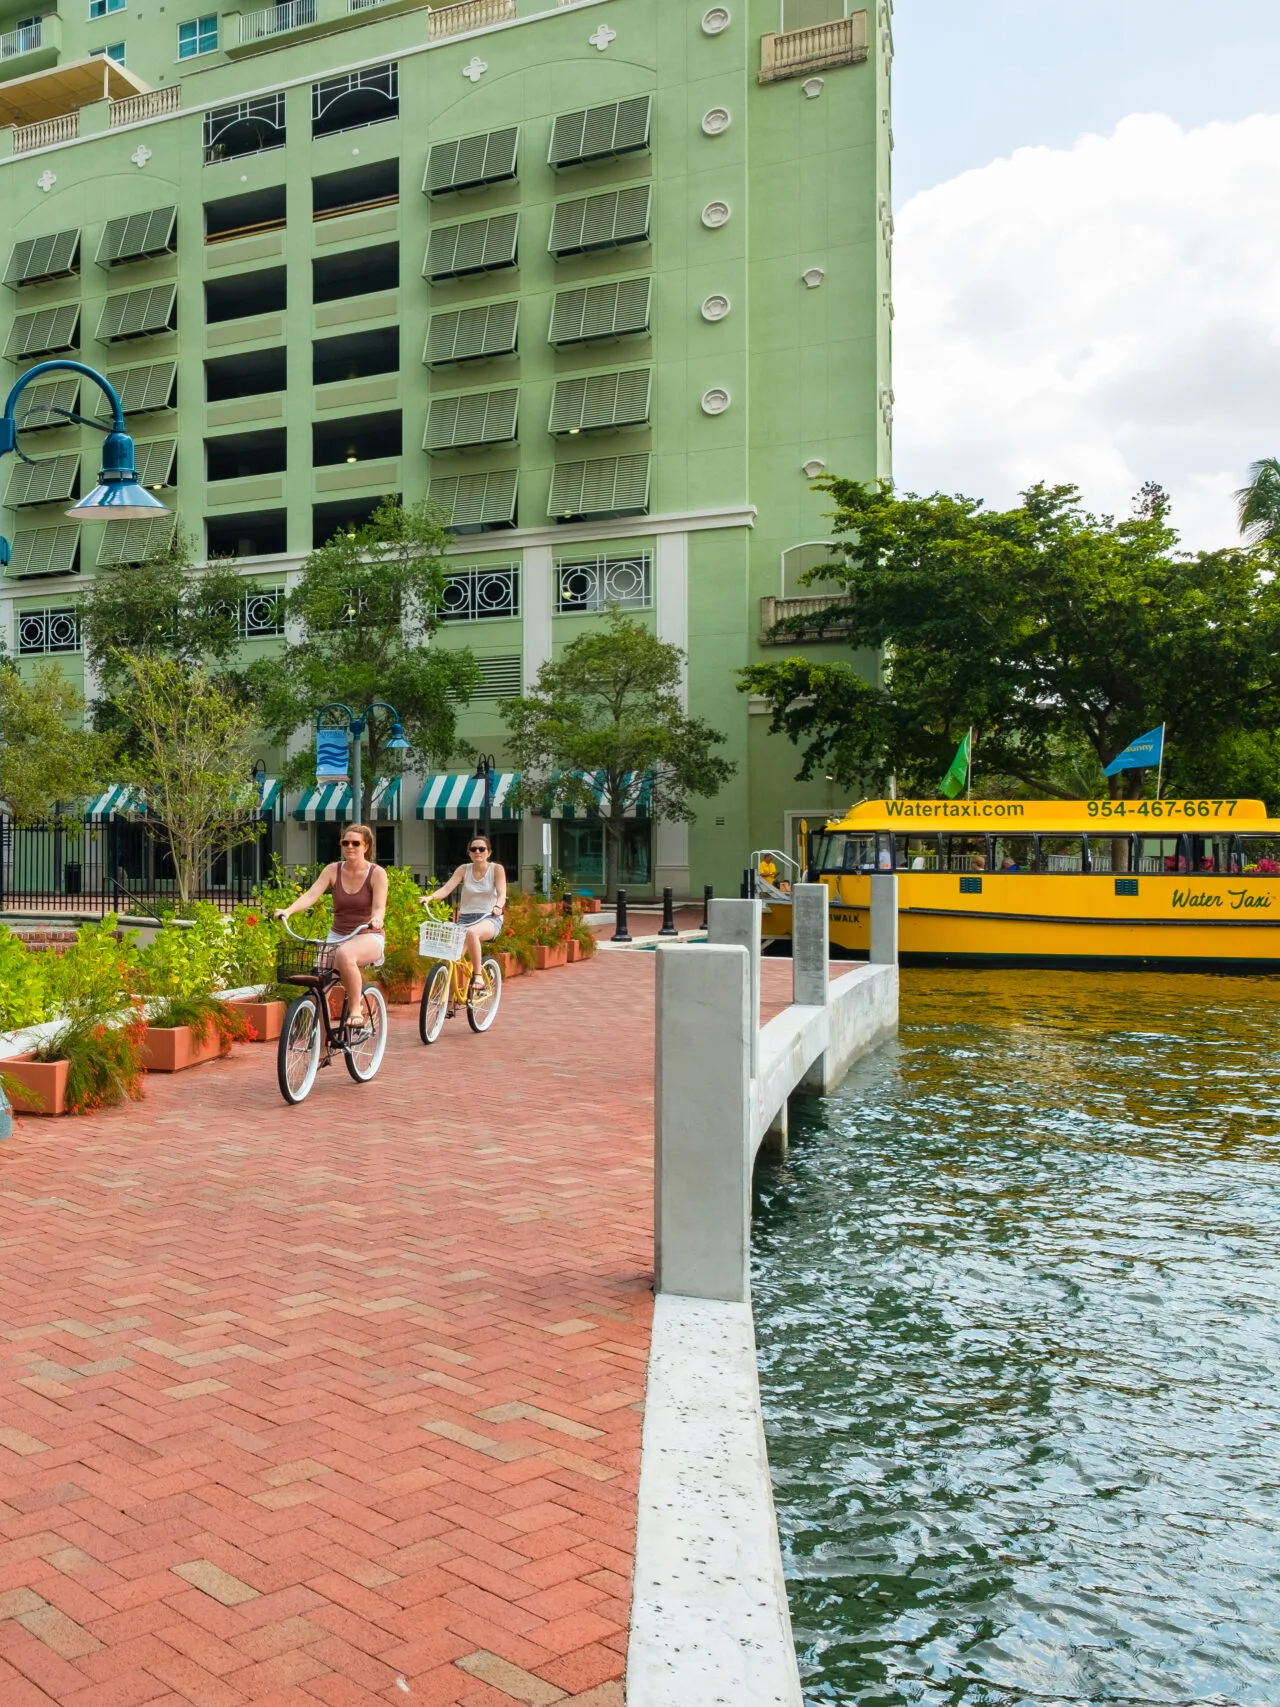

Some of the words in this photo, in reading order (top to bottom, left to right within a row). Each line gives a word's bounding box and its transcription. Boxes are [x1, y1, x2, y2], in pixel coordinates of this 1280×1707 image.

[885, 801, 1024, 817] Watertaxi.com
[1086, 800, 1238, 817] 954-467-6677
[1172, 888, 1224, 908] Water
[1227, 889, 1272, 910] Taxi
